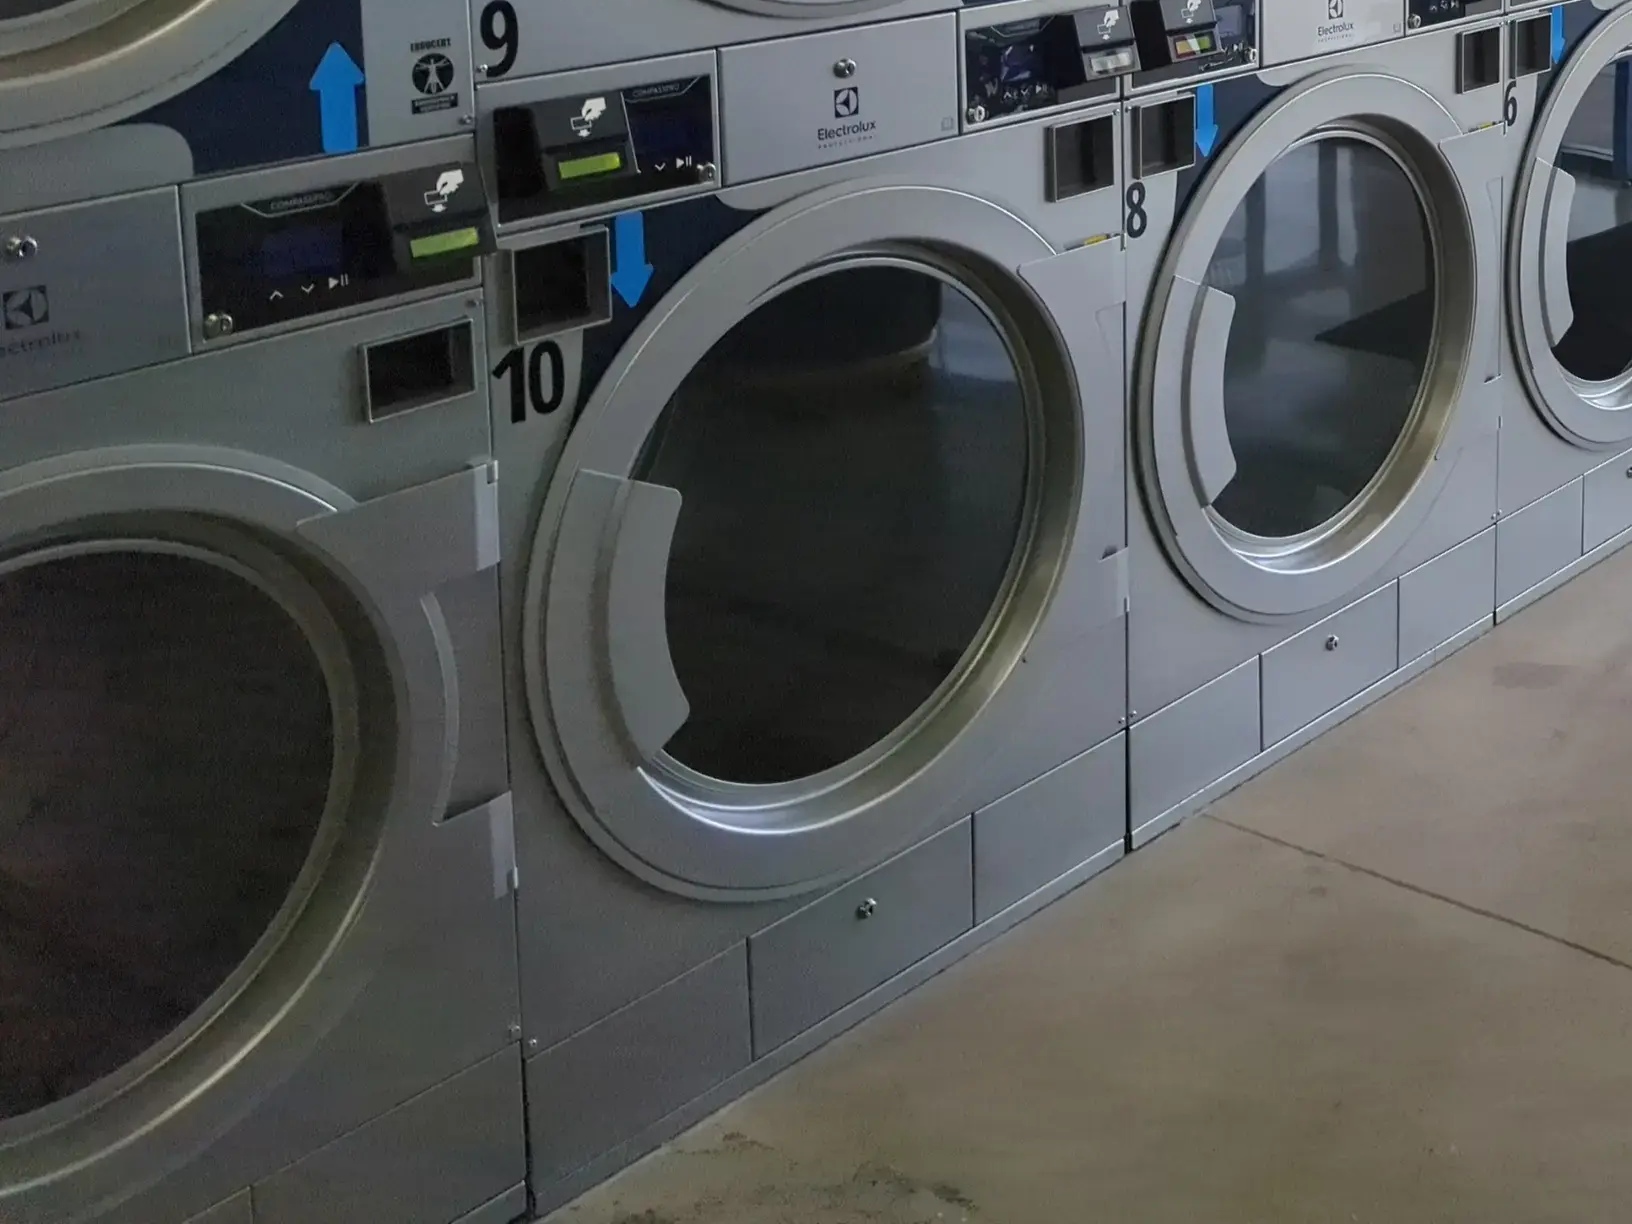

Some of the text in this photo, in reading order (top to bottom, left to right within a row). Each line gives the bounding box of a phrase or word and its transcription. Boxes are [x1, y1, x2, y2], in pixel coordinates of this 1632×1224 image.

[479, 0, 519, 79] 9
[1317, 22, 1354, 36] Electrolux
[1503, 80, 1517, 127] 6
[817, 120, 876, 141] Electrolux
[1126, 181, 1147, 239] 8
[491, 339, 566, 424] 10
